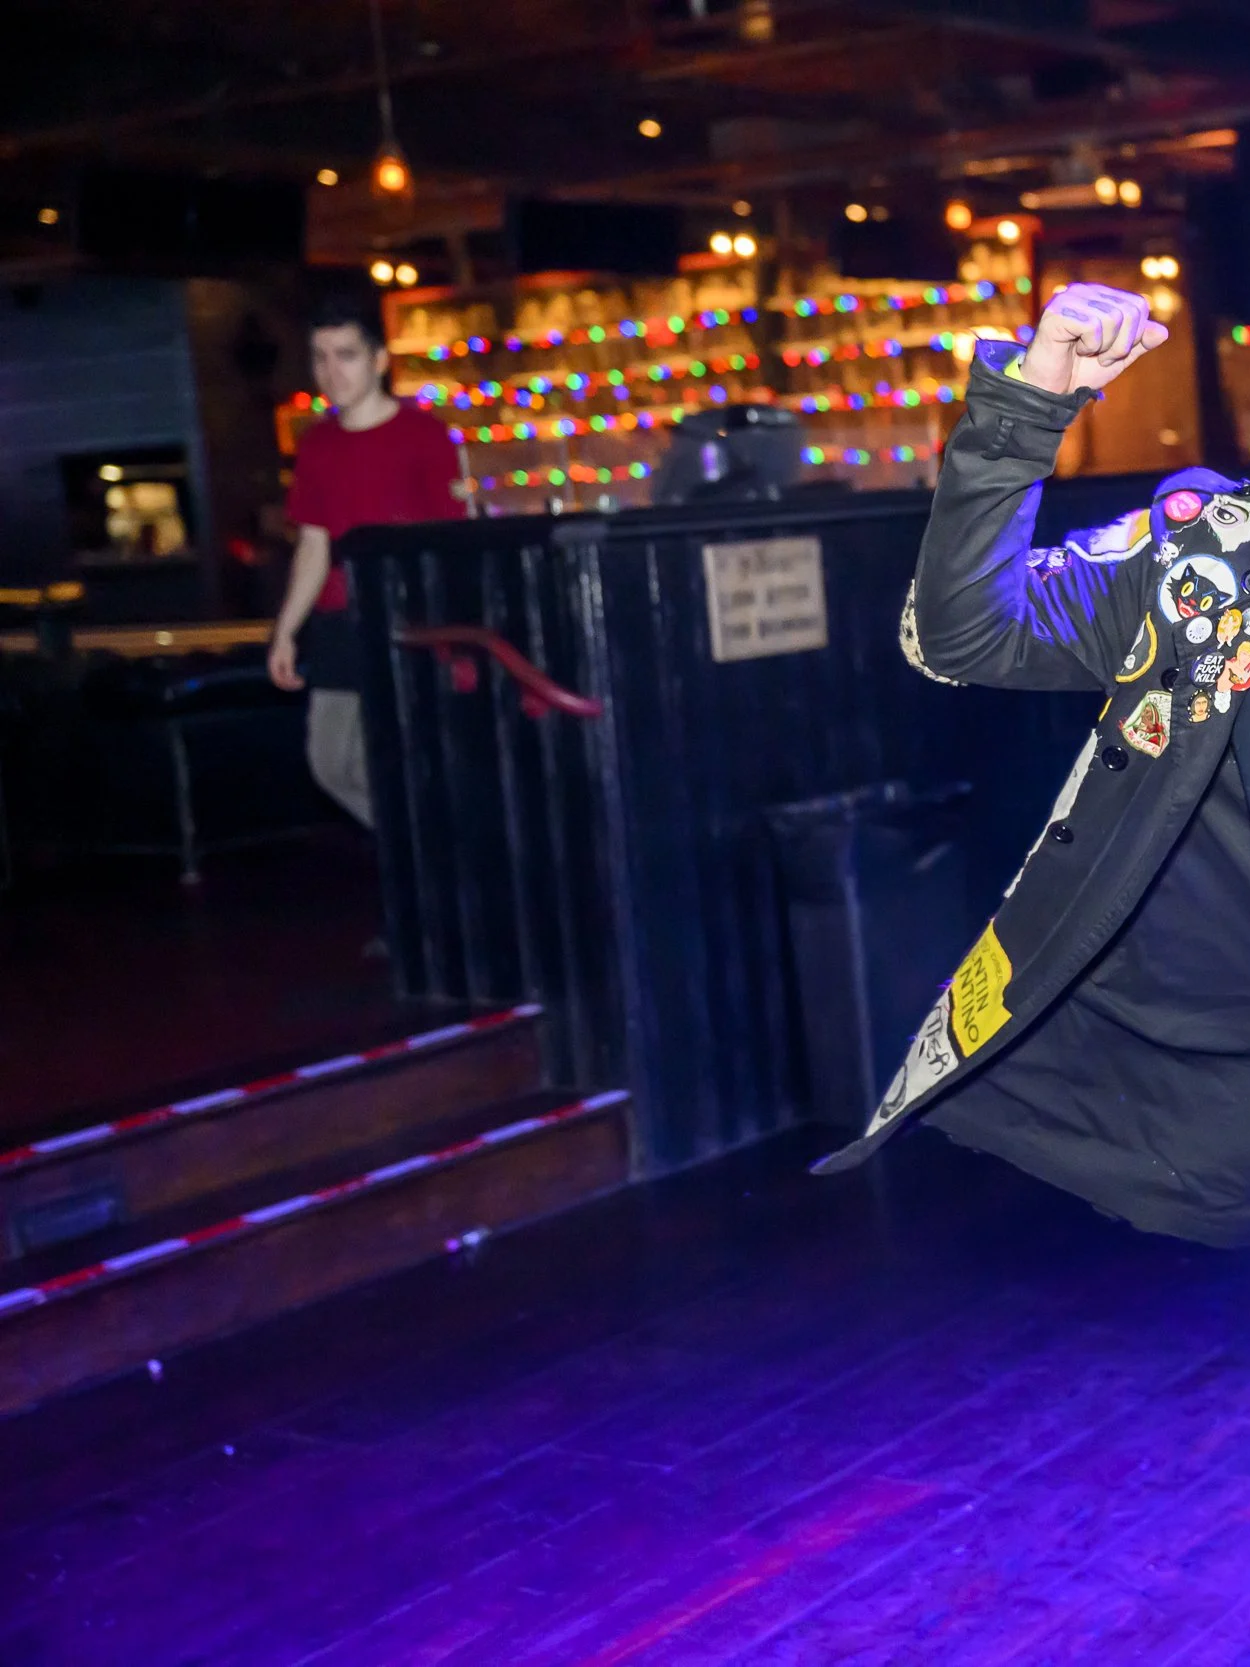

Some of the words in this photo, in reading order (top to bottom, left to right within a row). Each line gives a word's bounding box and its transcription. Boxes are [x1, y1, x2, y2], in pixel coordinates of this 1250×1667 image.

[1203, 655, 1225, 665] EAT
[1195, 664, 1224, 674] FUCK
[1195, 673, 1216, 683] KILL
